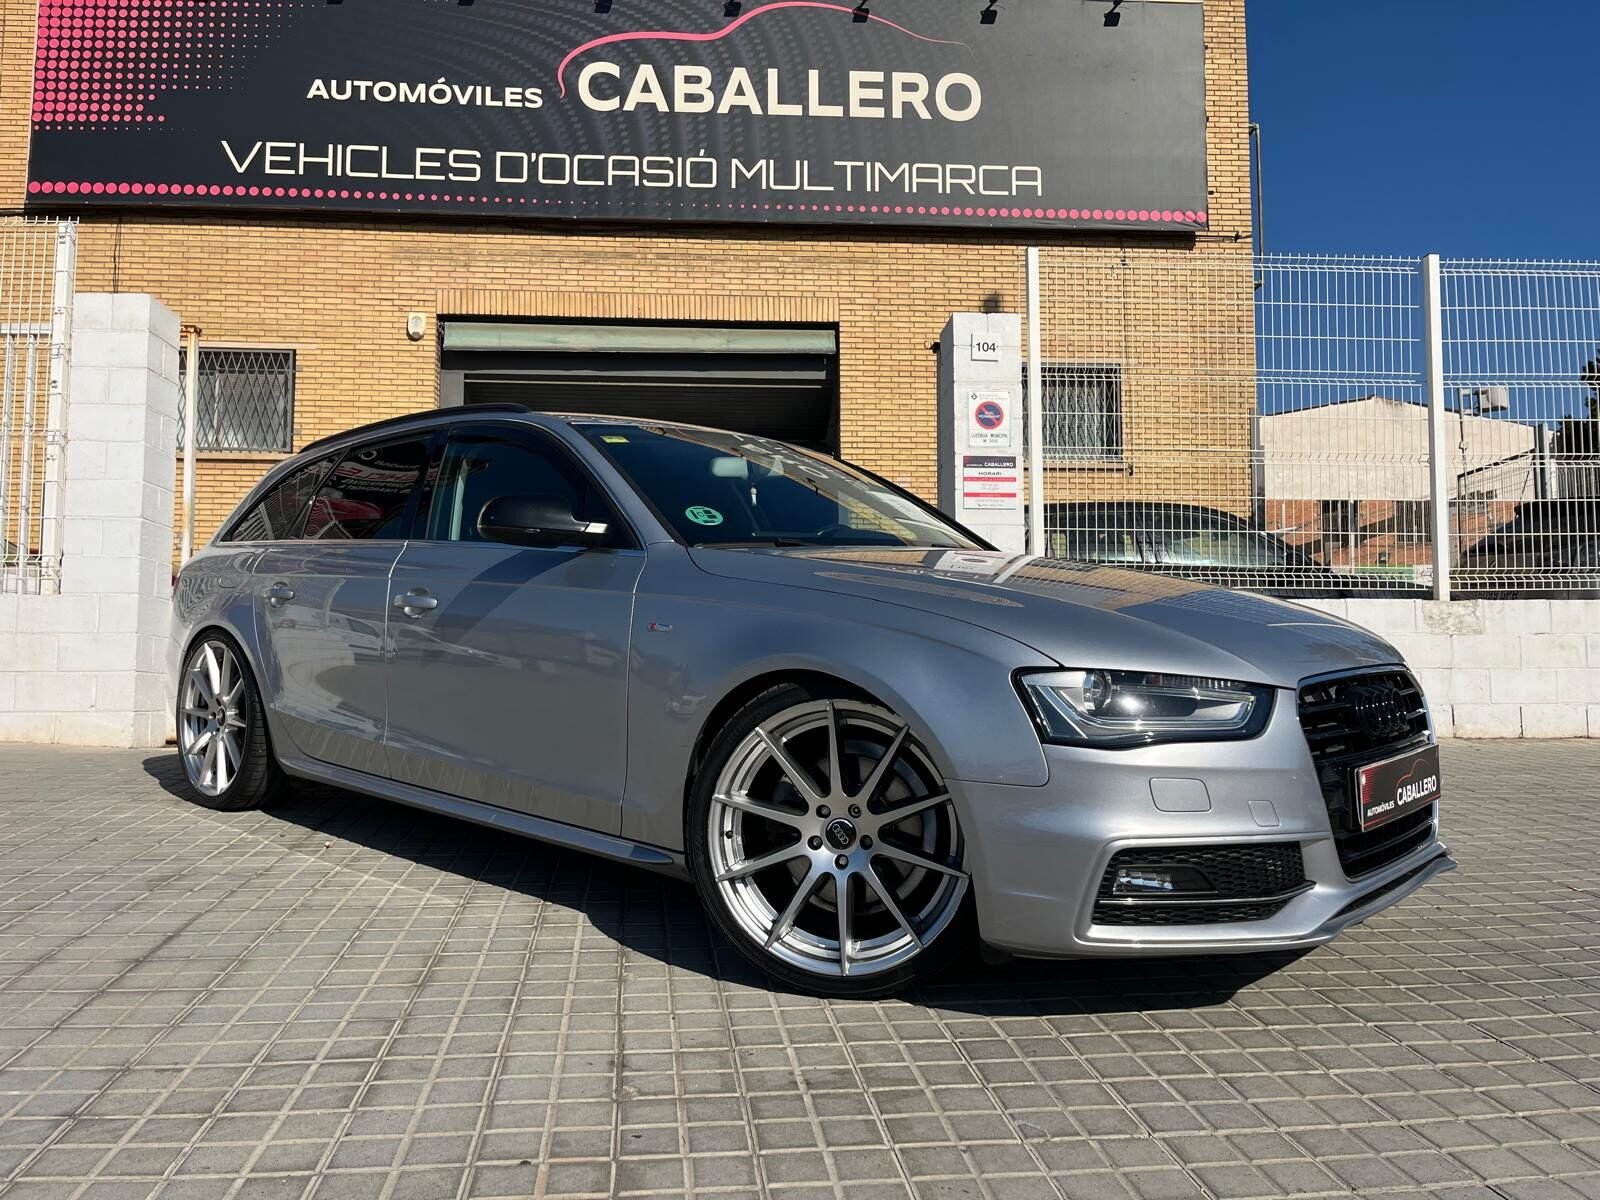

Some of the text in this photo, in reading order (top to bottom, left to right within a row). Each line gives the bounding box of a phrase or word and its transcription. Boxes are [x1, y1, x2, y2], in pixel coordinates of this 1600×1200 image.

[306, 61, 982, 122] AUTOMÓVILES CABALLERO
[221, 140, 1043, 197] VEHICLES D'OCASIÓ MULTIMARCA
[1367, 775, 1437, 817] AUTOMÓVILES CABALLERO
